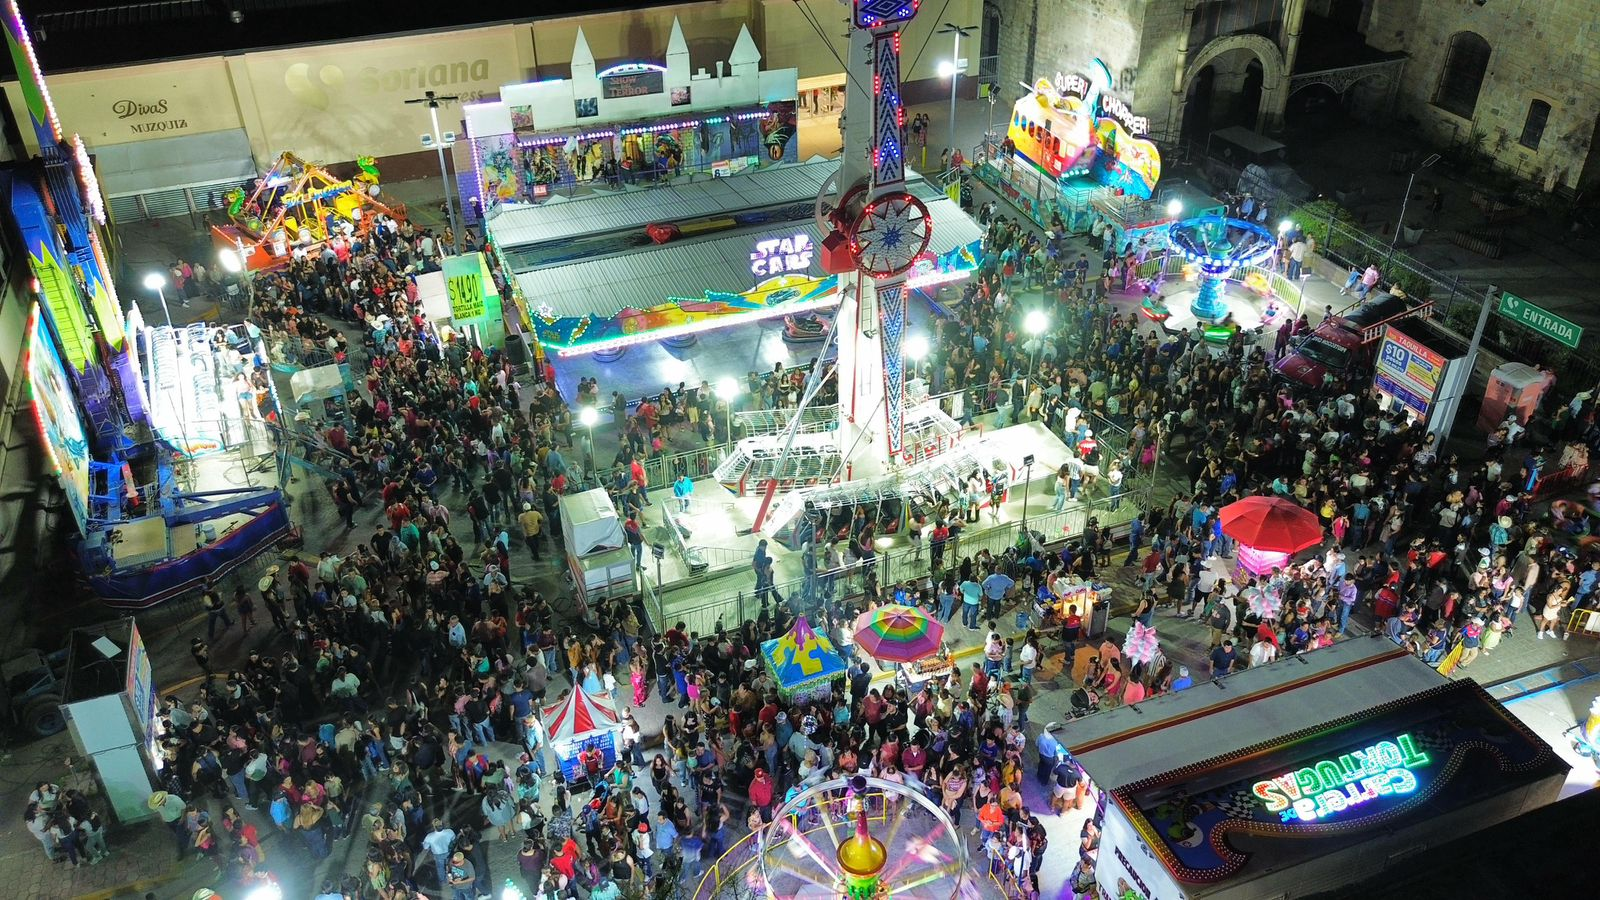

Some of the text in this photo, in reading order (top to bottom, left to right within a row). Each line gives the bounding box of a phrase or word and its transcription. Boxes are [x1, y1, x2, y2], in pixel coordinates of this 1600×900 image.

[360, 59, 489, 94] Soriana
[609, 86, 648, 97] TERROR
[130, 119, 188, 134] MUZQUIZ
[751, 235, 813, 259] STAR
[752, 251, 813, 276] CARS
[1523, 307, 1573, 340] ENTRADA
[1385, 343, 1405, 361] $10
[1399, 337, 1428, 359] TAQUILLA
[1252, 733, 1430, 812] TORTUGAS
[1292, 768, 1417, 821] Carrera
